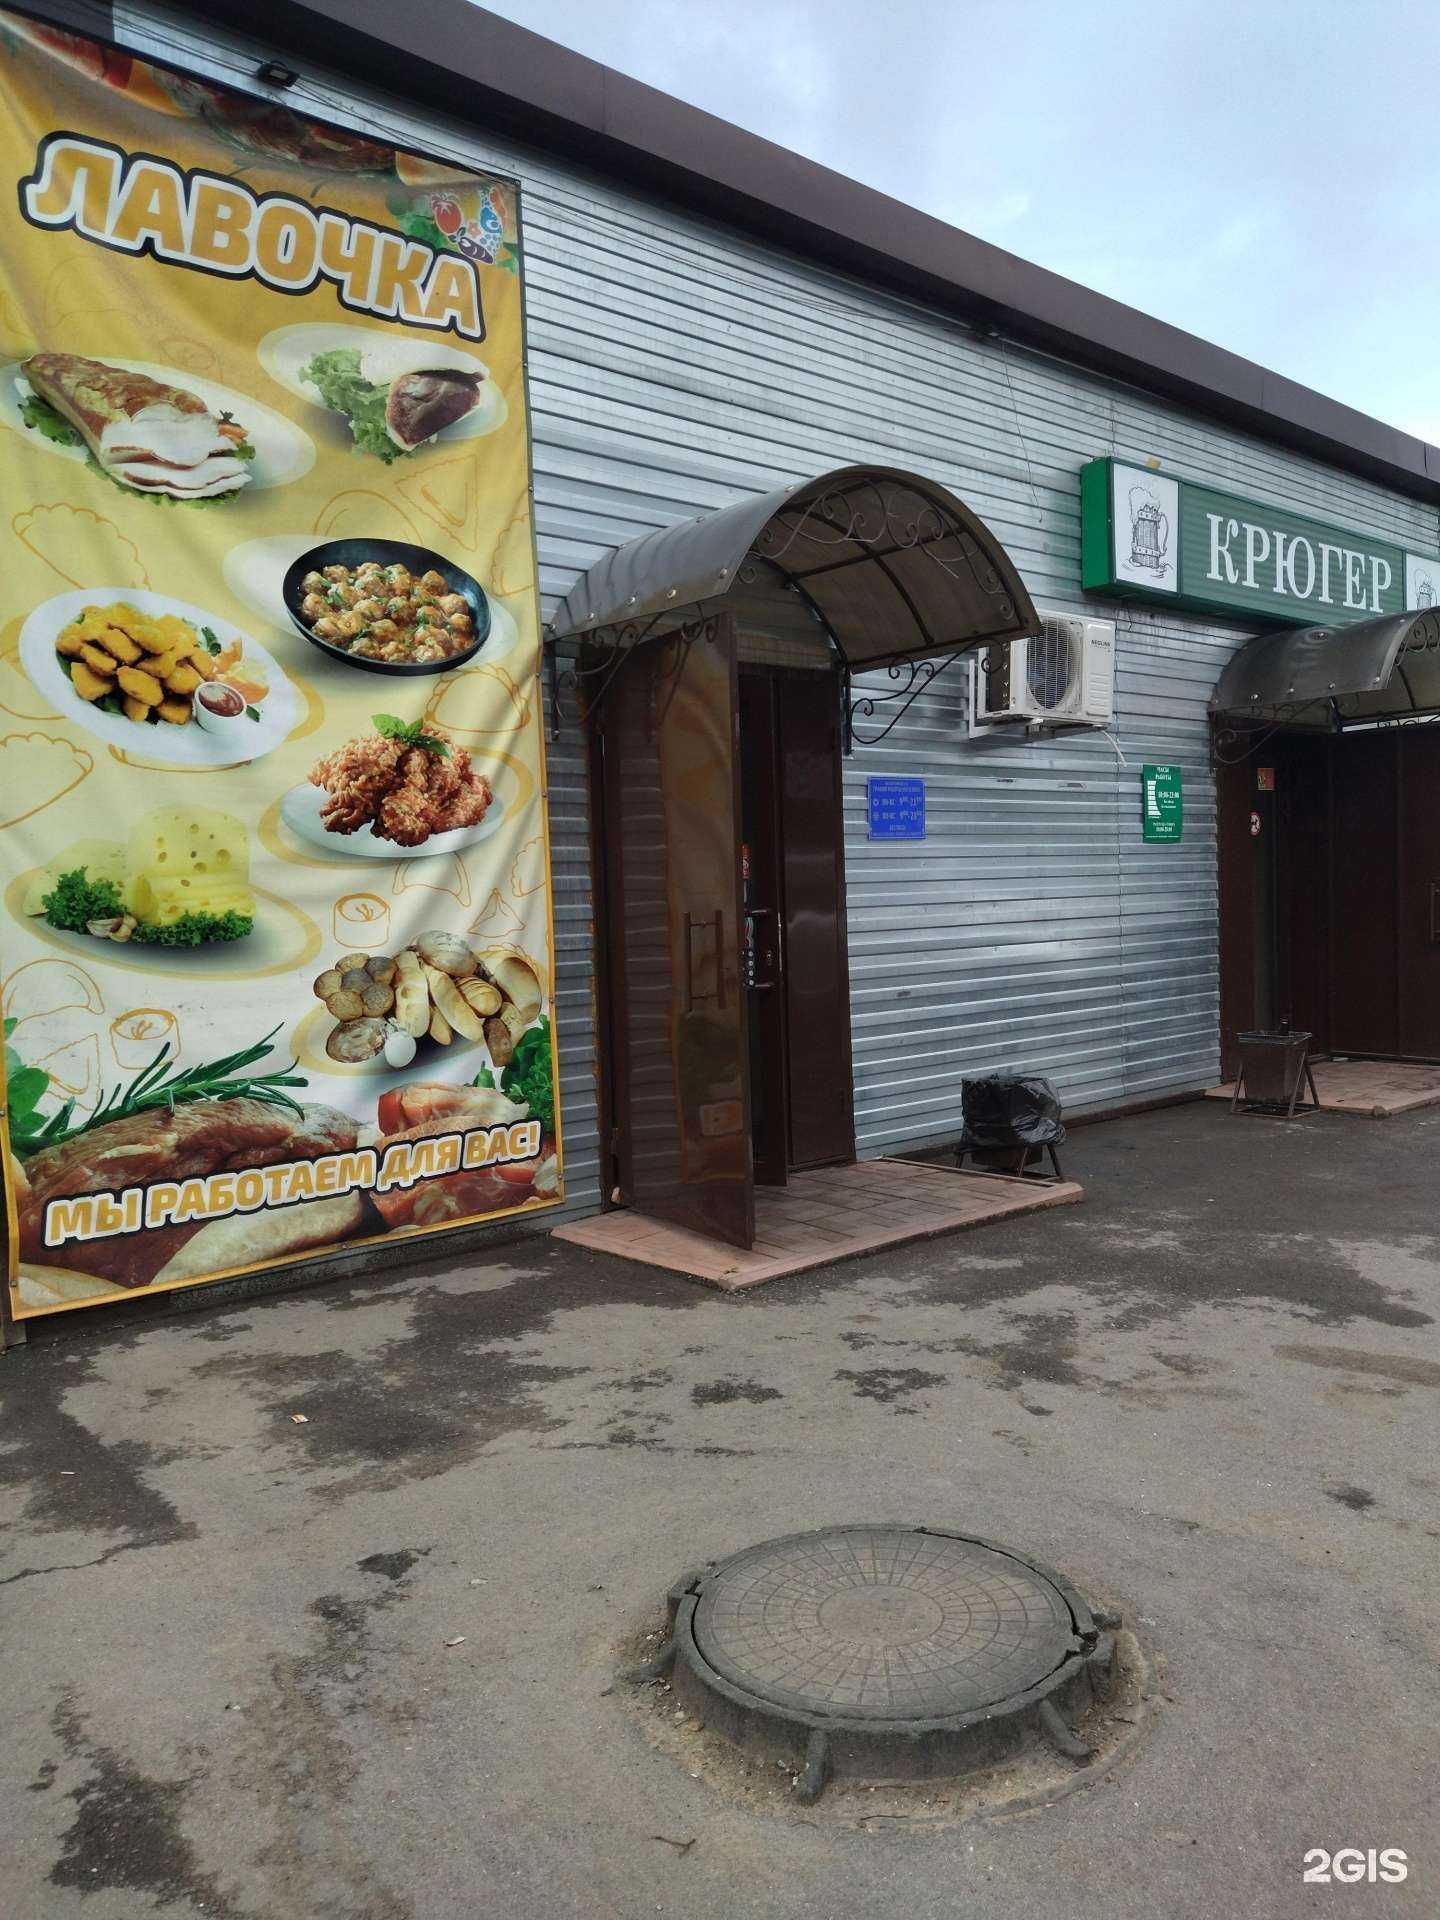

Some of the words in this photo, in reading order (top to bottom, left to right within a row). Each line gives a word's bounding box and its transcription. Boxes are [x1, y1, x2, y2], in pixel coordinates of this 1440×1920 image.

[20, 134, 485, 341] ЛАВОЧКА
[1206, 513, 1392, 614] КРЮГЕР
[45, 1185, 142, 1246] МЫ
[146, 1152, 377, 1229] РАБОТАЕМ
[378, 1134, 461, 1190] ДЛЯ
[464, 1121, 542, 1169] ВАС!
